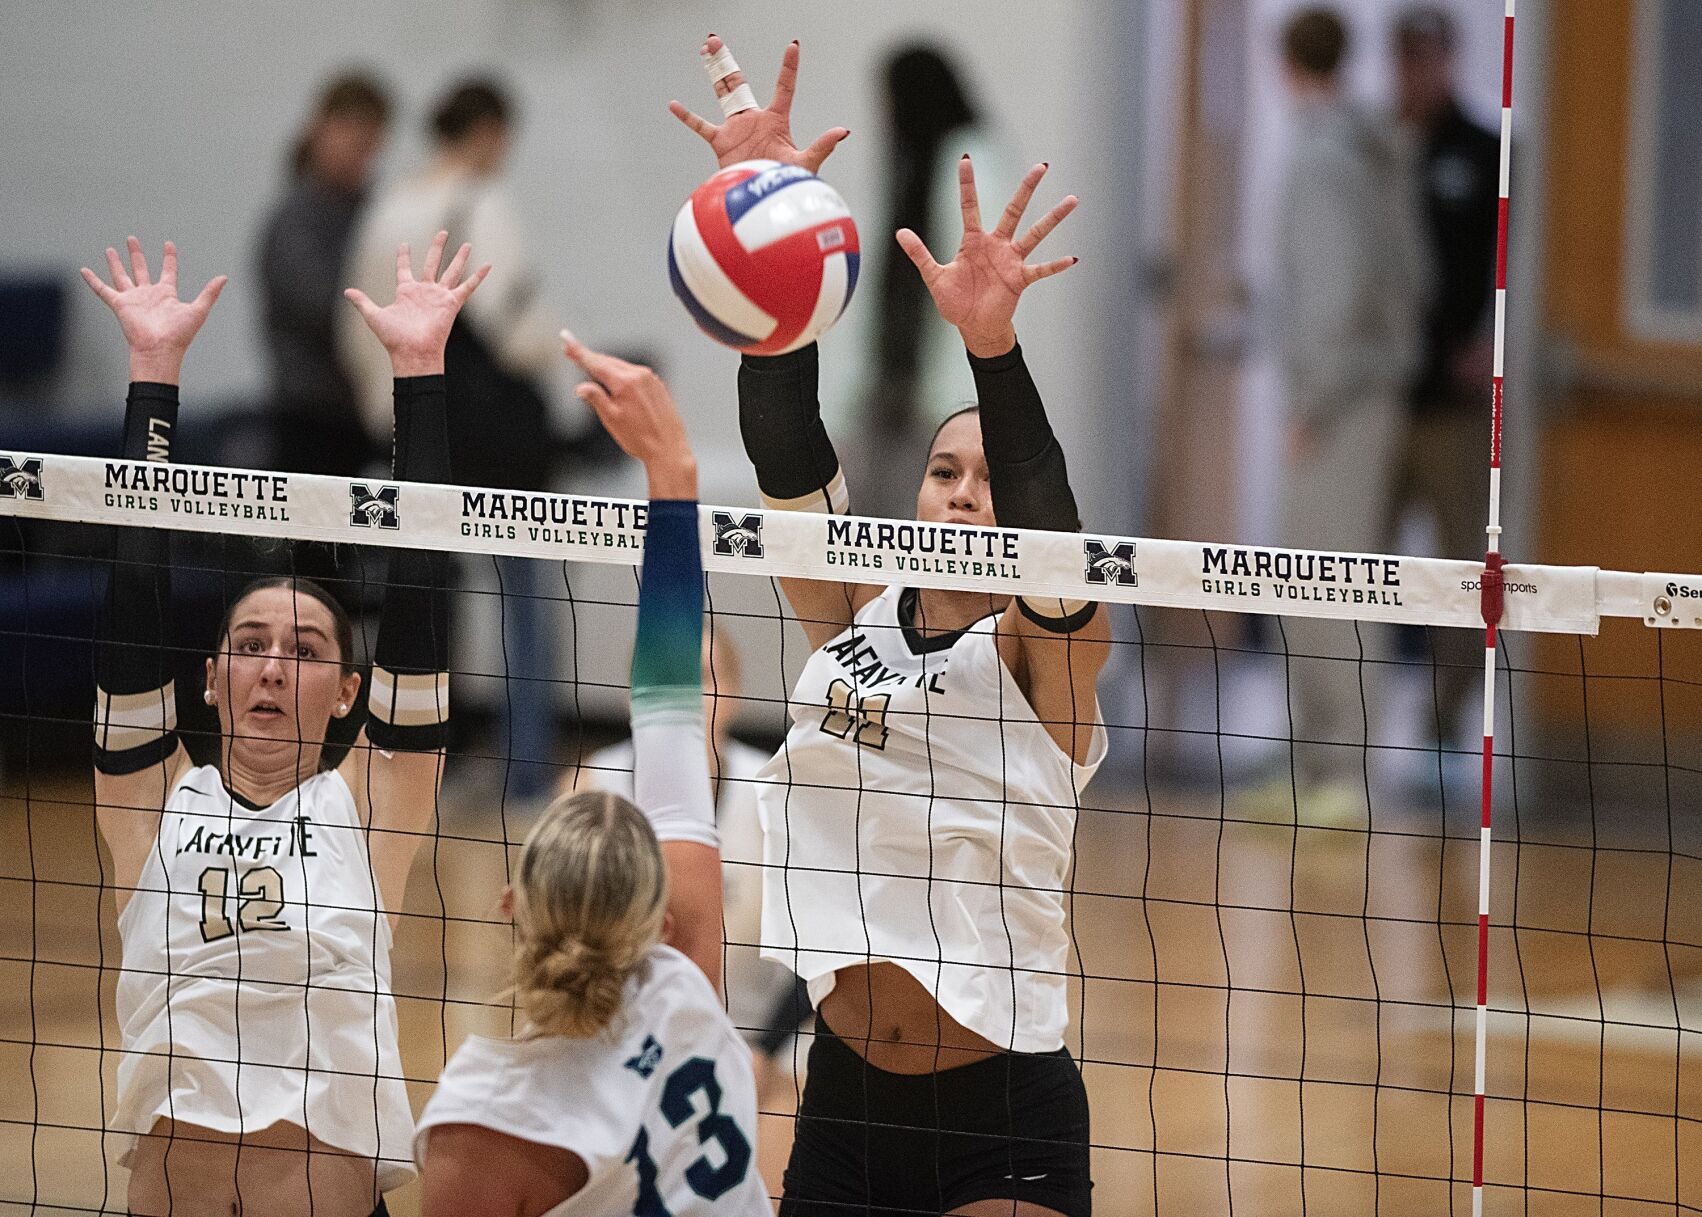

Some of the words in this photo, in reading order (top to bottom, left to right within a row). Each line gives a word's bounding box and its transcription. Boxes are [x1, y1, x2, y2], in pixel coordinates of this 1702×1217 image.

[105, 464, 288, 502] MARQUETTE
[105, 493, 158, 511] GIRLS
[171, 499, 290, 522] VOLLEYBALL
[461, 491, 648, 530] MARQUETTE
[461, 522, 516, 540] GIRLS
[827, 519, 1019, 560] MARQUETTE
[826, 551, 884, 569] GIRLS
[896, 556, 1021, 580] VOLLEYBALL
[1202, 547, 1401, 587] MARQUETTE
[1202, 579, 1261, 598] GIRLS
[1273, 584, 1403, 606] VOLLEYBALL
[1503, 582, 1538, 594] mports
[1680, 585, 1702, 598] Se
[198, 866, 291, 943] 12
[624, 1056, 752, 1217] 13
